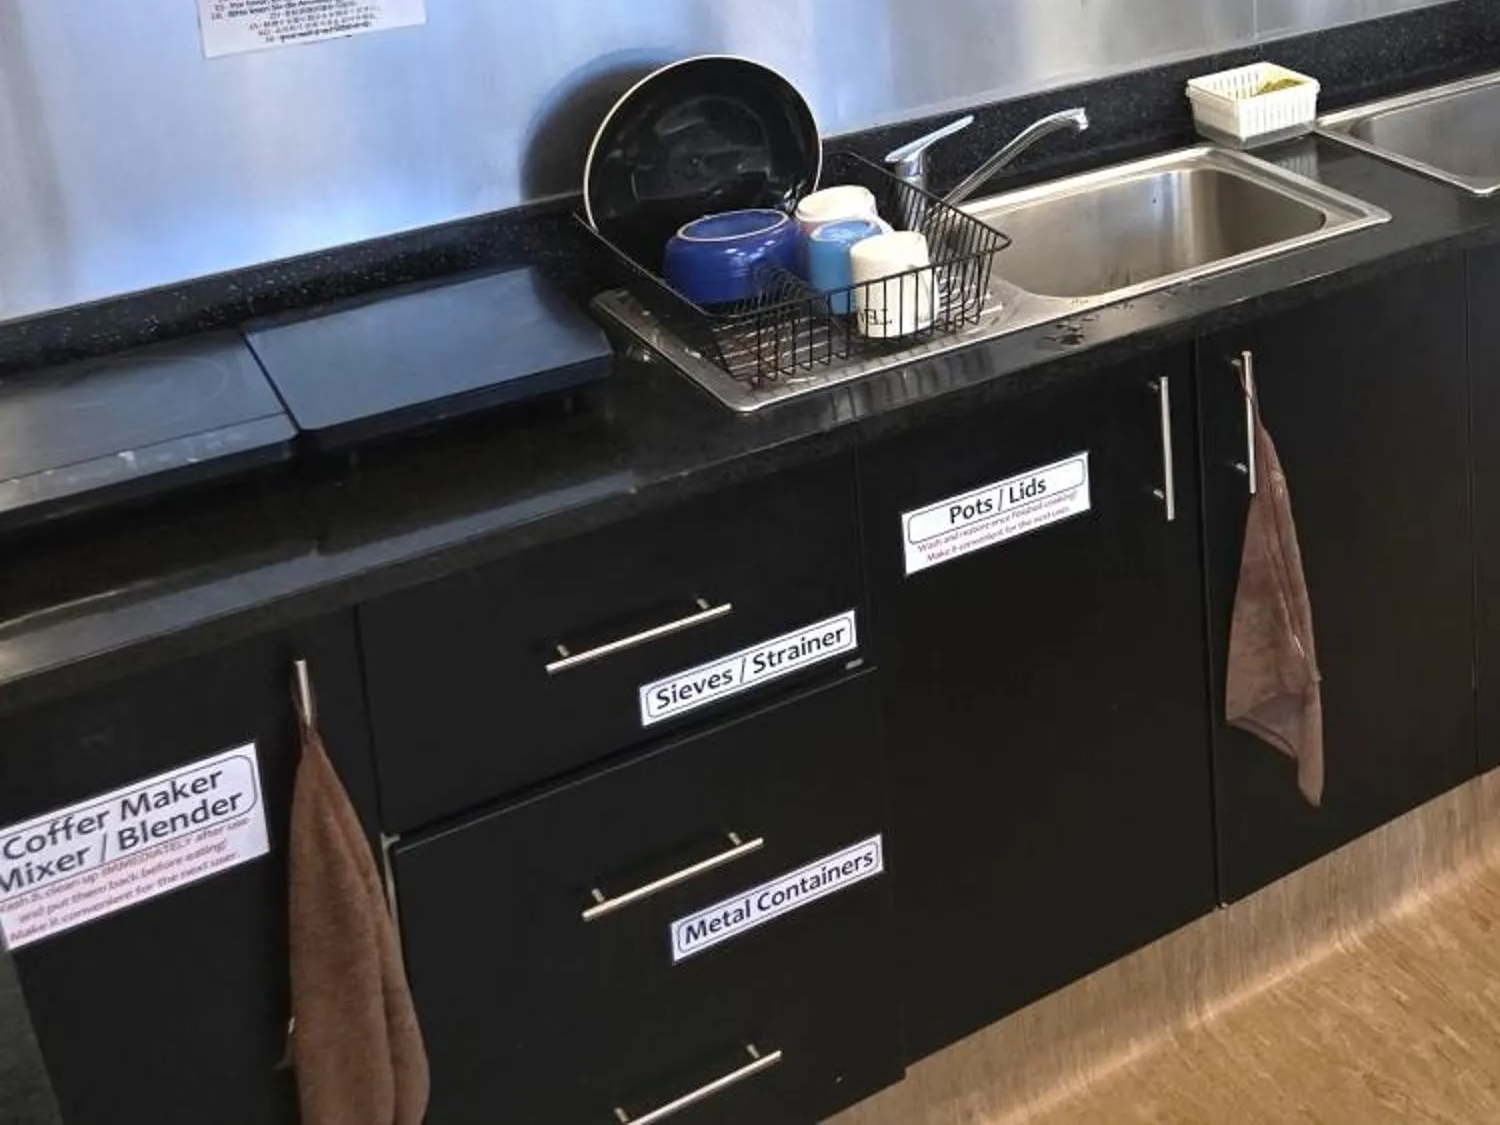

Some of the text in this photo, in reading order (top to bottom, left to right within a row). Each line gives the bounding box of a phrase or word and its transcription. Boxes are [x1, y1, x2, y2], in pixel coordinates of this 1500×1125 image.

[949, 497, 994, 524] Pots
[1008, 478, 1047, 505] Lids
[654, 668, 733, 711] Sieves
[751, 625, 845, 675] Strainer
[0, 844, 91, 894] Mixer
[117, 791, 243, 852] Blender
[3, 769, 223, 861] Coffer Maker
[683, 848, 874, 945] Metal Containers
